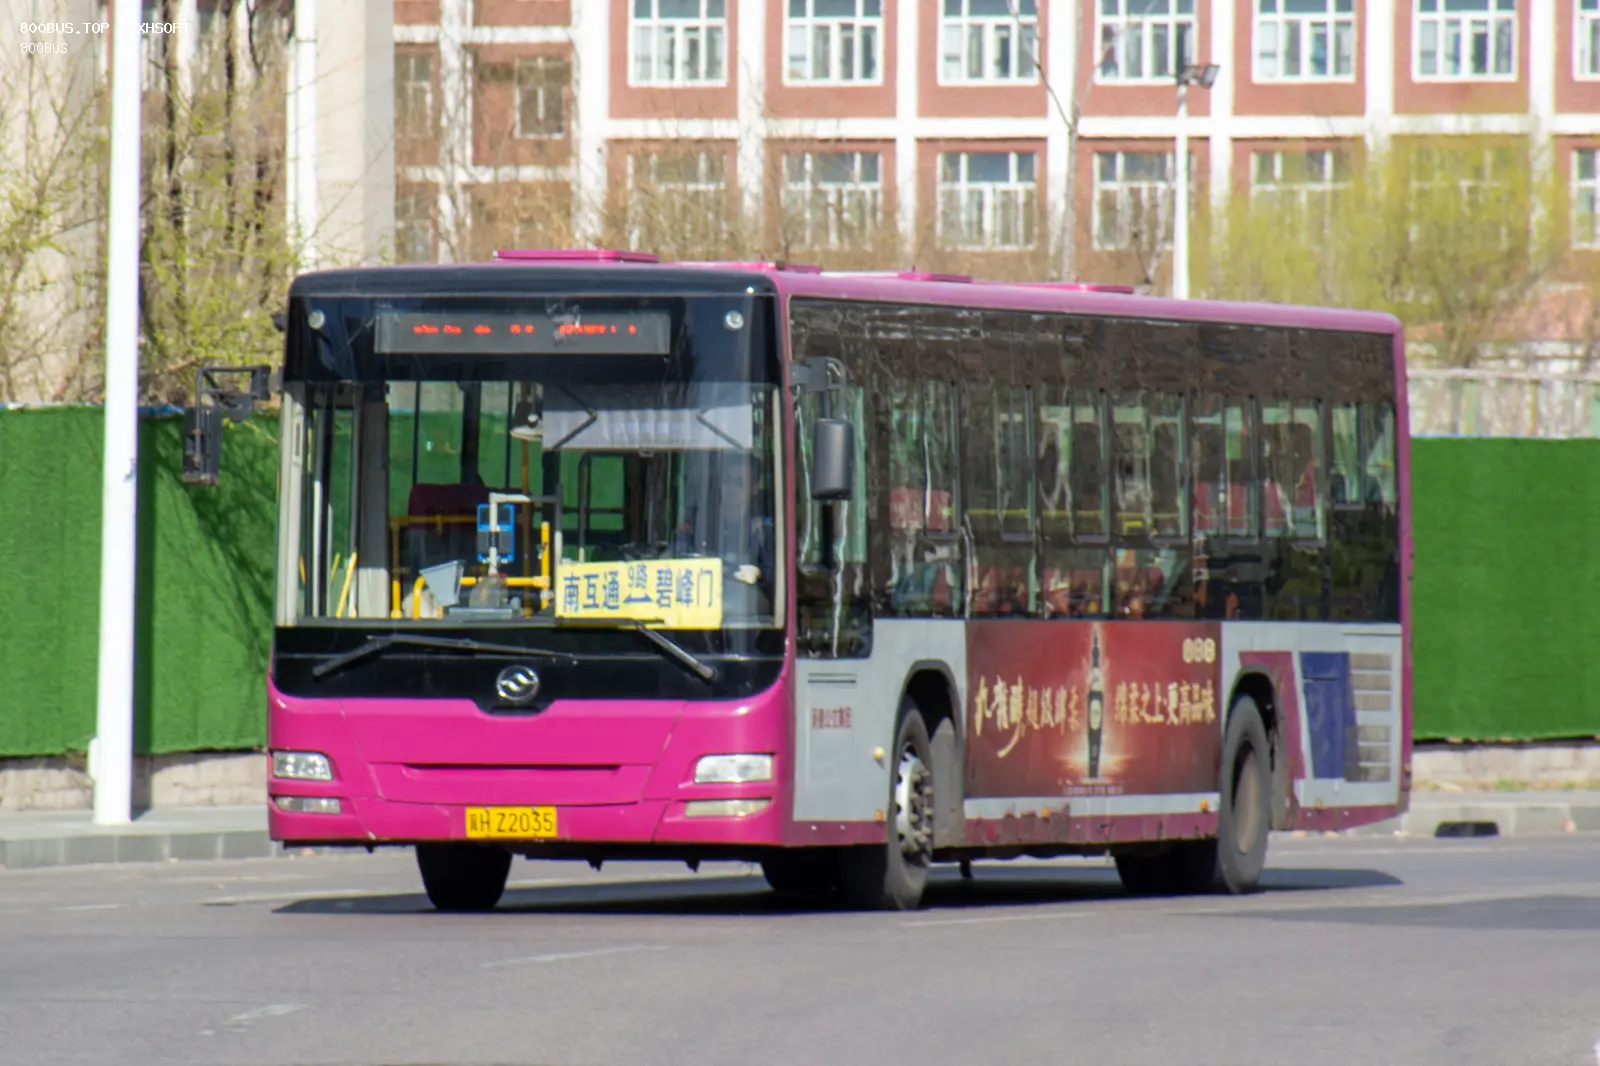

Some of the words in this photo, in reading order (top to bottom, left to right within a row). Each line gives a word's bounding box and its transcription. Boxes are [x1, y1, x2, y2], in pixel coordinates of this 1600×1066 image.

[563, 570, 620, 613] 南互通
[655, 566, 714, 610] 碧峰门
[496, 812, 553, 832] Z2035
